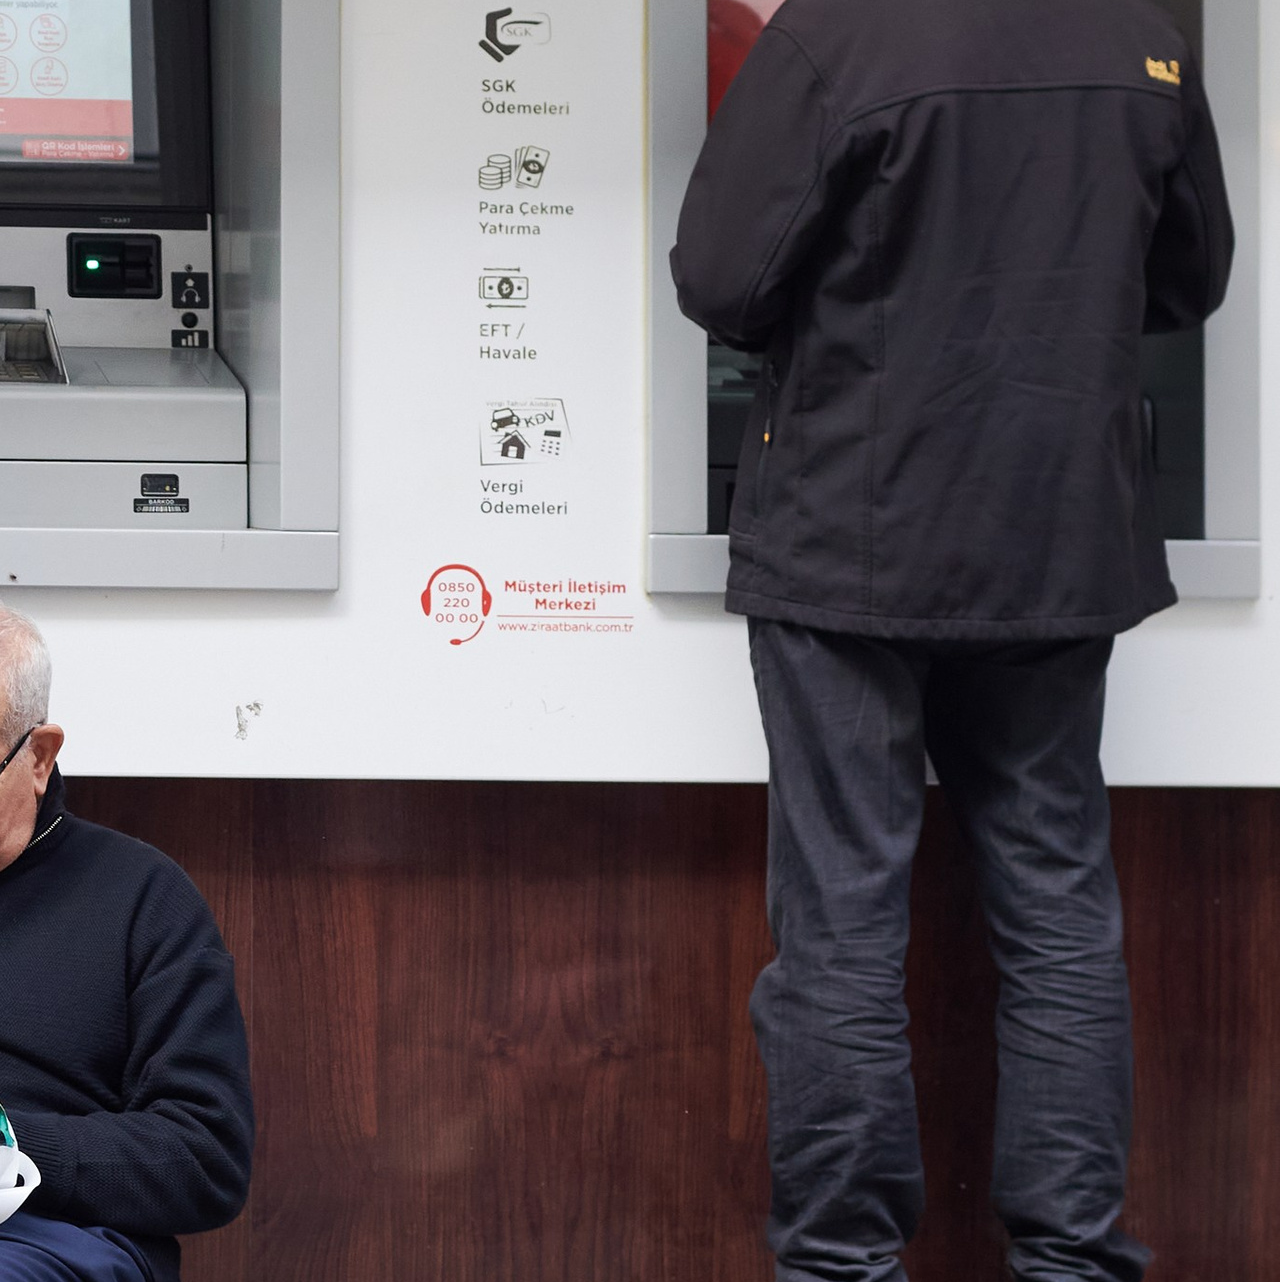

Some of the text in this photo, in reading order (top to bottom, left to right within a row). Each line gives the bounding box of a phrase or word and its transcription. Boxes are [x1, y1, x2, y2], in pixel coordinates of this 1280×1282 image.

[506, 27, 533, 37] SGK
[481, 79, 516, 93] SGK
[481, 96, 570, 115] Ödemeleri
[57, 142, 75, 151] Kod
[478, 201, 575, 216] Para Çekme
[478, 221, 541, 236] Yatırma
[479, 322, 526, 340] EFT /
[479, 345, 537, 360] Havale
[523, 409, 555, 428] KDV
[480, 479, 524, 495] Vergi
[480, 497, 568, 515] Ödemeleri
[438, 582, 475, 593] 0850
[504, 578, 626, 596] Müşteri İletişim
[443, 598, 470, 608] 220
[535, 598, 596, 611] Merkezi
[435, 613, 479, 624] 00 00
[497, 622, 634, 633] www.ziraatbank.com.tr
